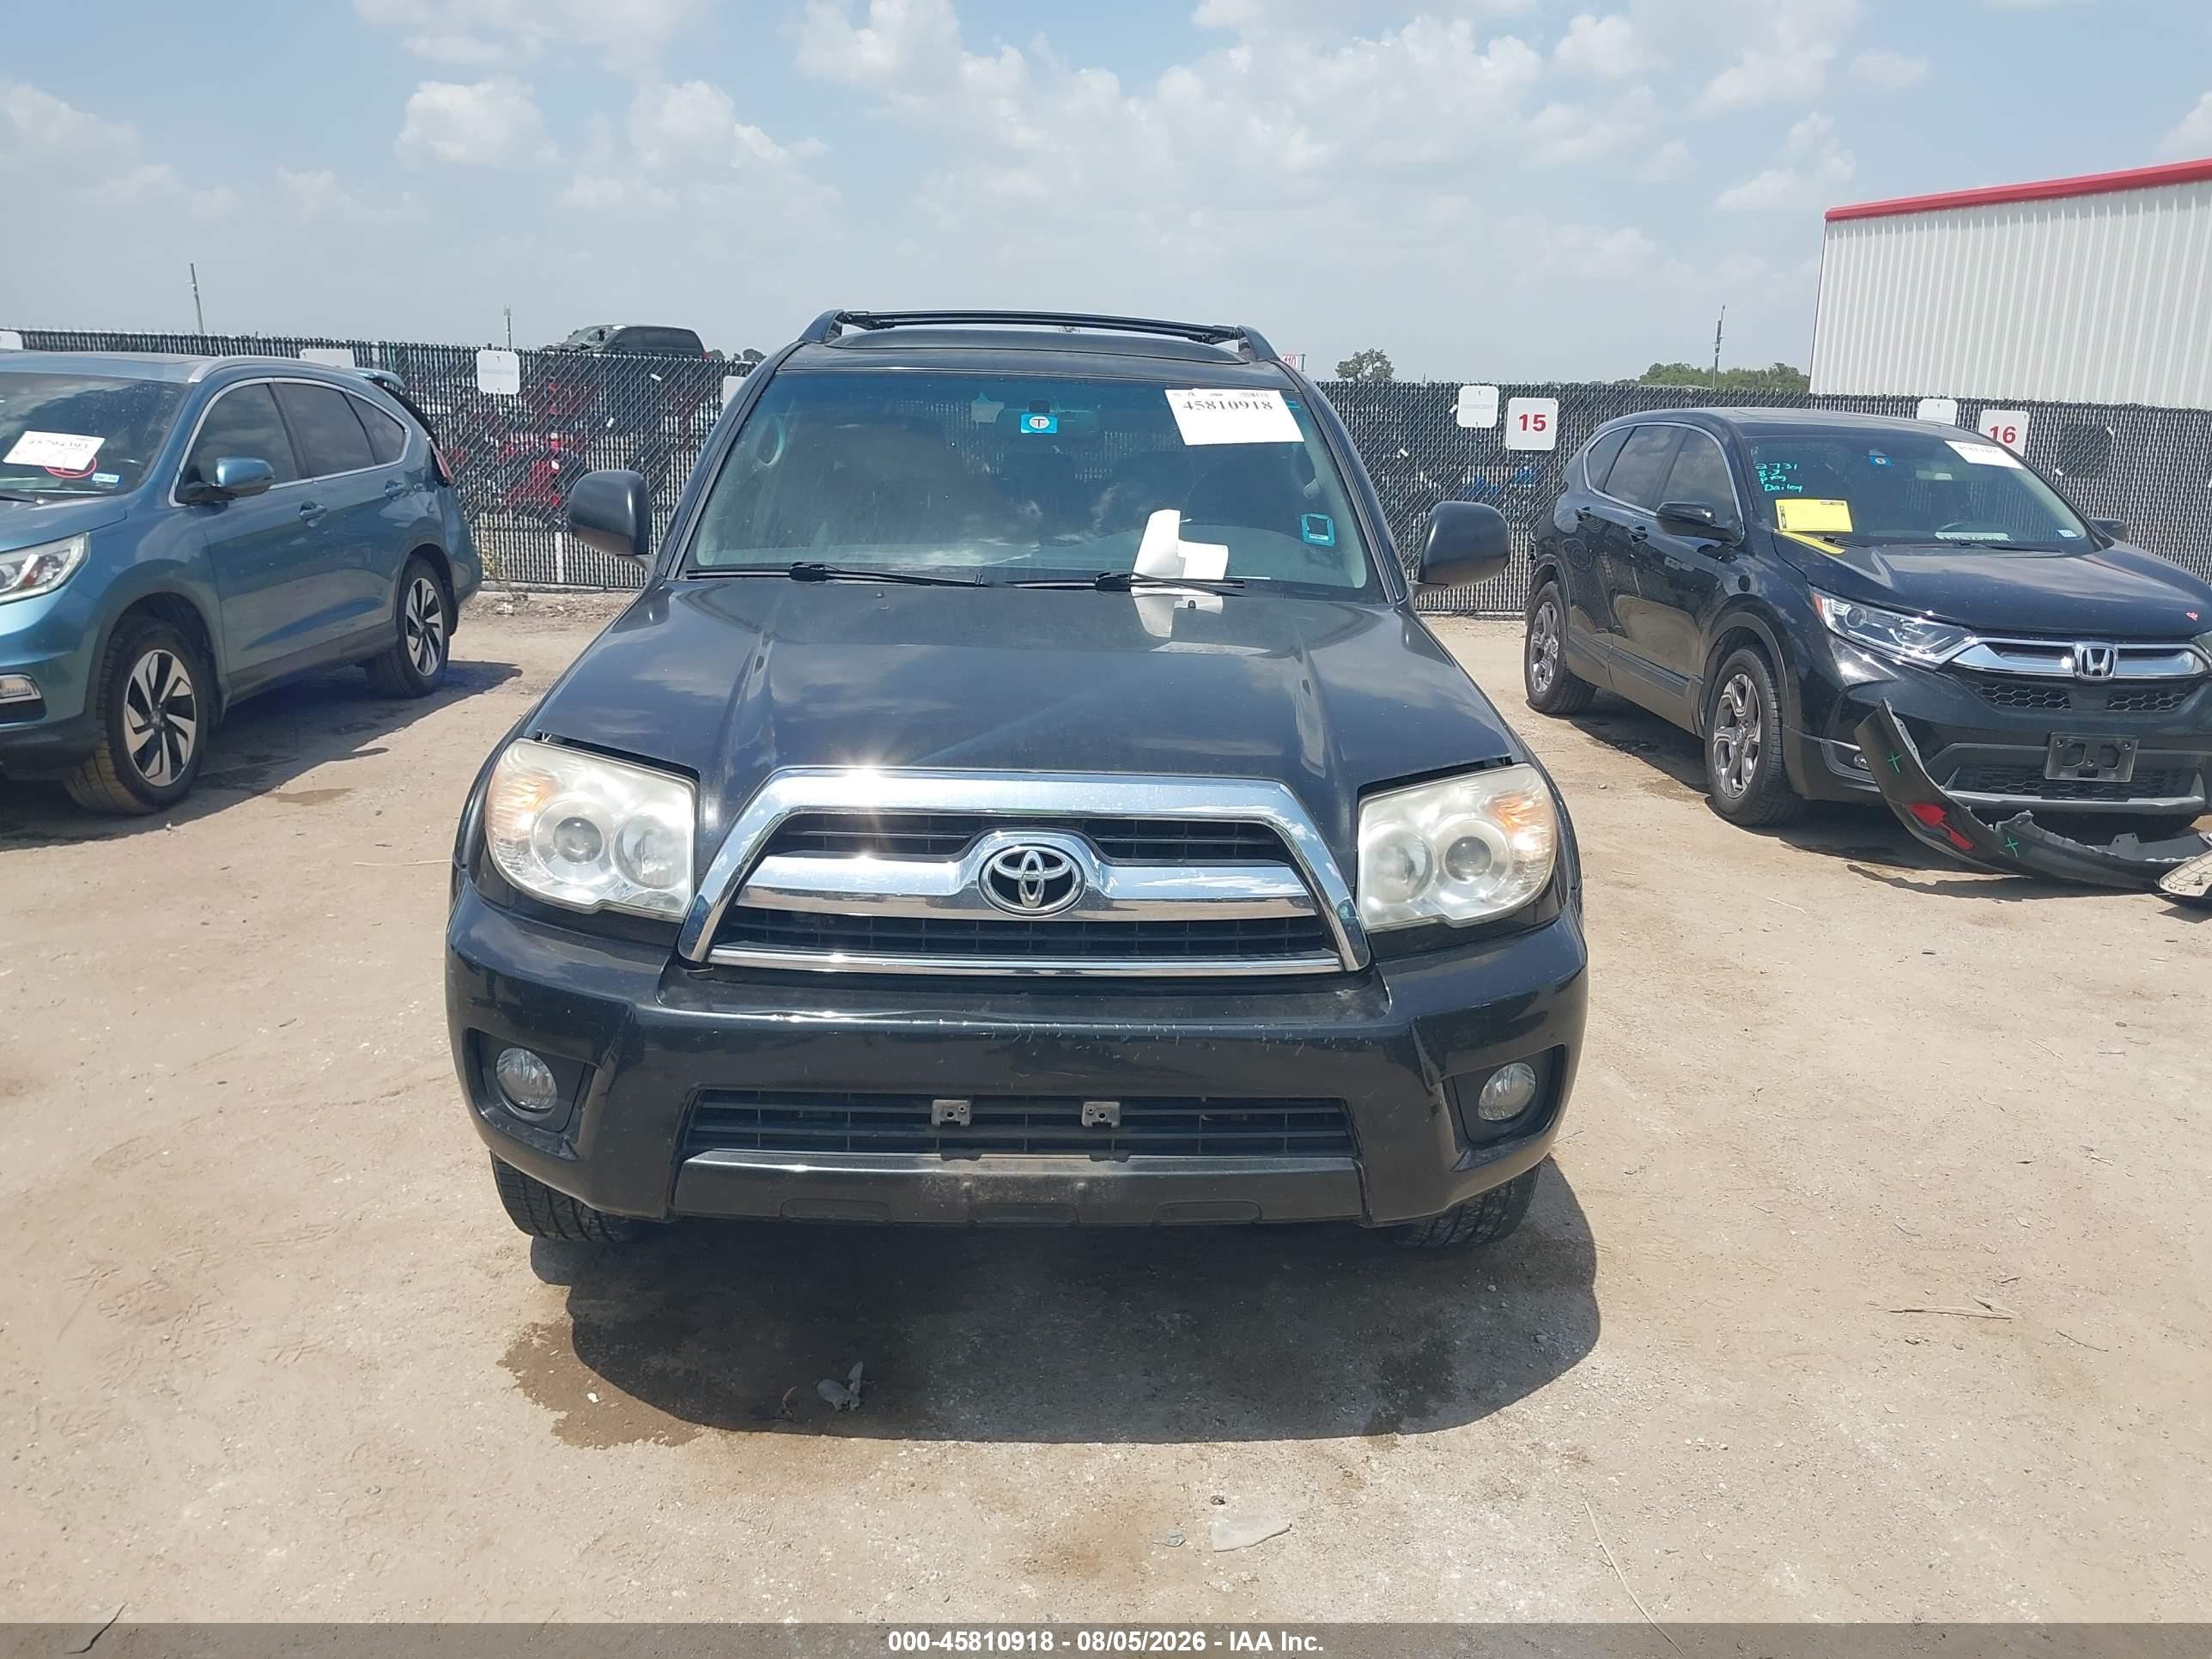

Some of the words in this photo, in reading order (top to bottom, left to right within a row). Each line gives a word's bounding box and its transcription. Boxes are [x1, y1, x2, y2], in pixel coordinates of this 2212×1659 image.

[1182, 400, 1273, 411] 45810918
[1519, 414, 1547, 432] 15
[1990, 426, 2017, 444] 16
